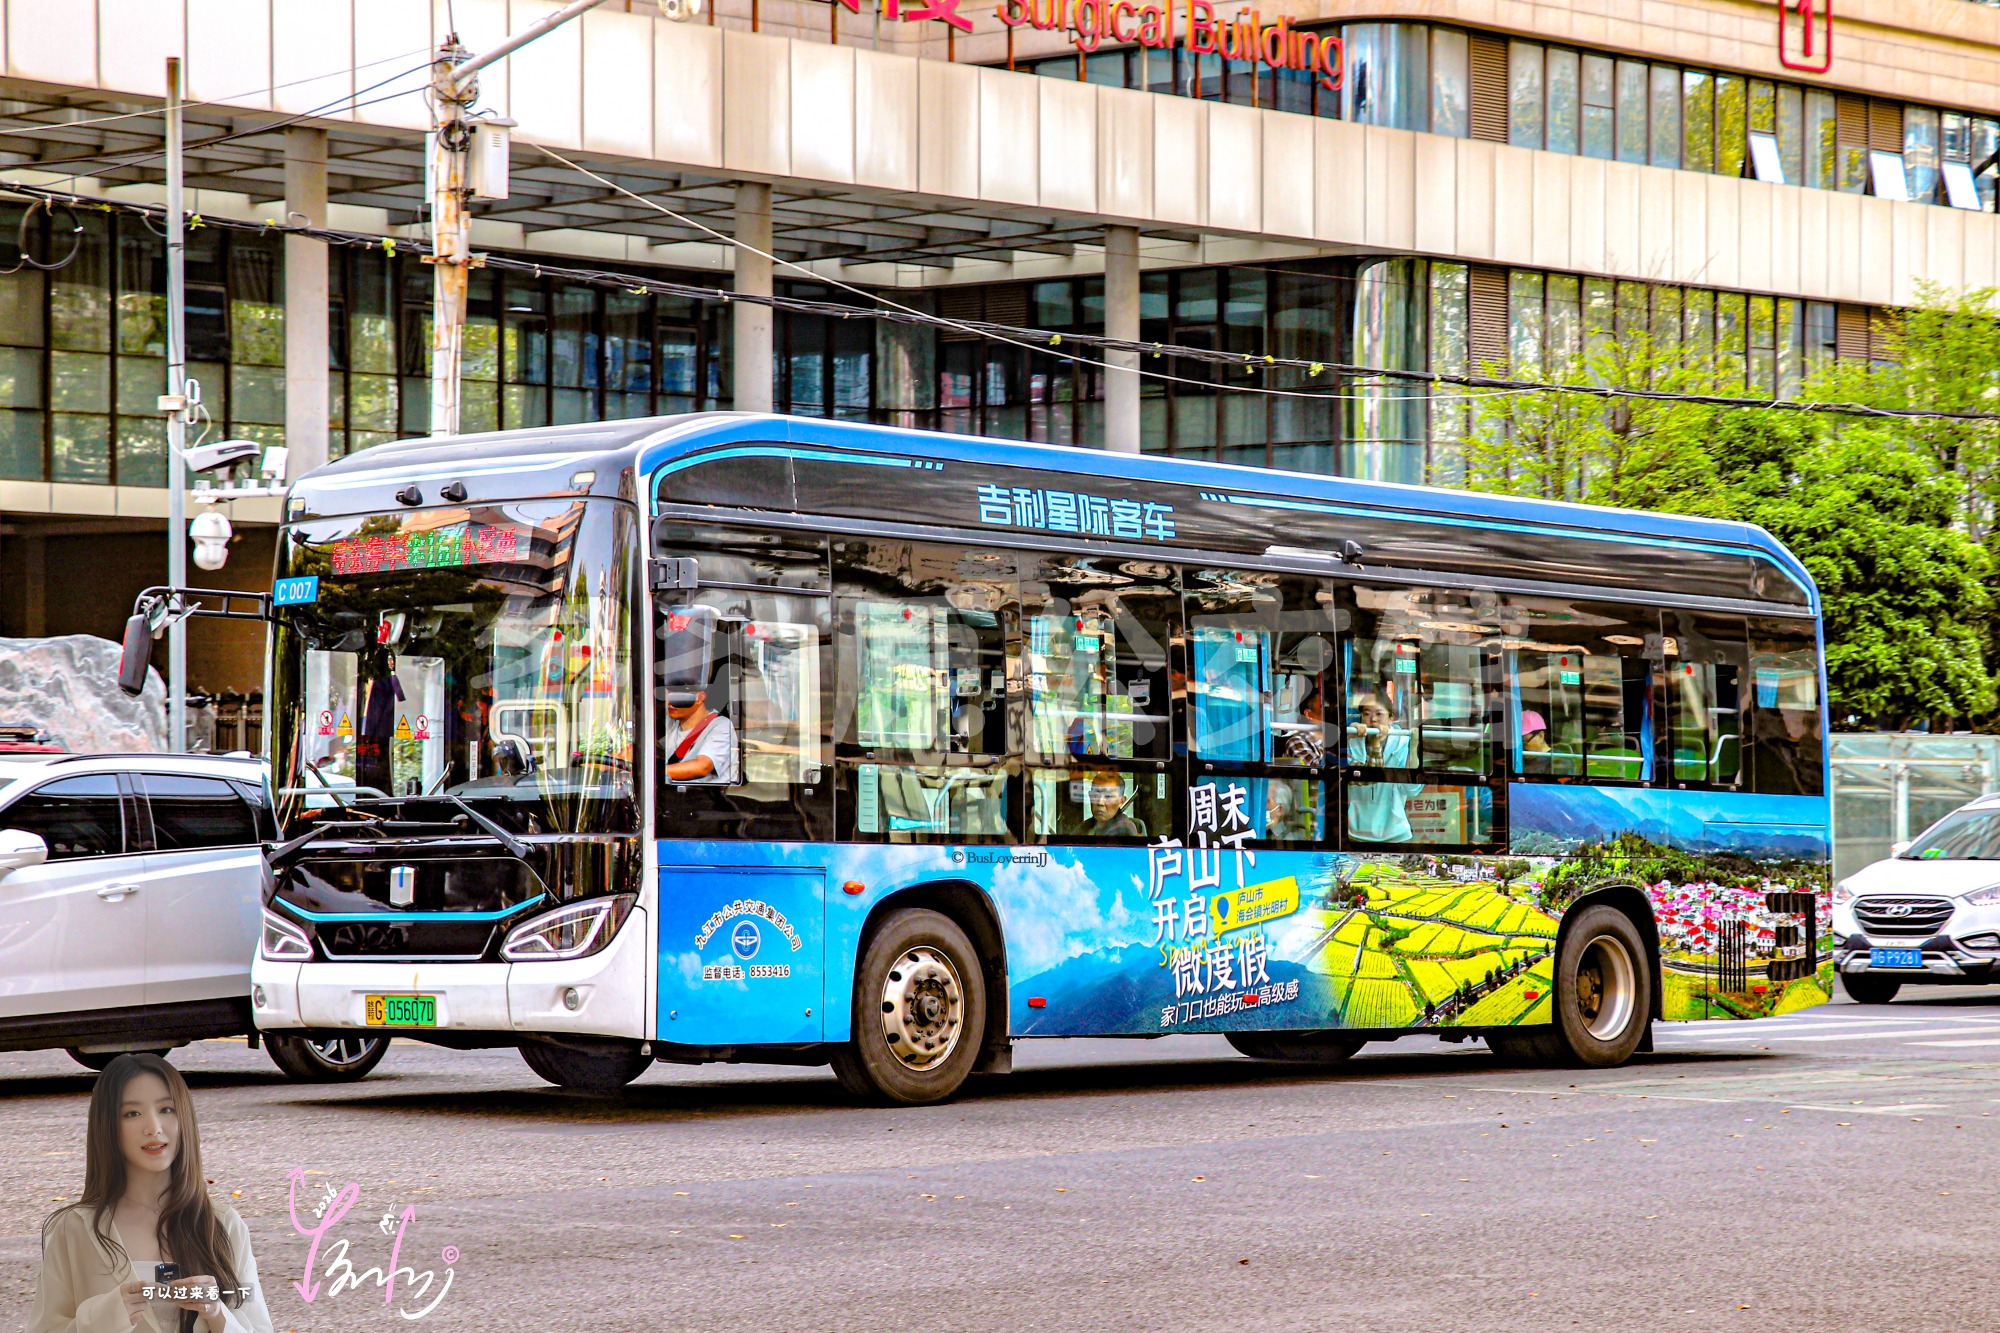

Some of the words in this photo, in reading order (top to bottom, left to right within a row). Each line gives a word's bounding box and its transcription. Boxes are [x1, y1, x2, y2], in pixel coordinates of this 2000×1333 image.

[1187, 0, 1345, 91] Building
[976, 484, 1176, 541] 吉利星际客车
[290, 582, 312, 600] 007
[1189, 782, 1250, 835] 周末
[1405, 799, 1447, 811] 老为
[1147, 829, 1257, 899] 庐山下
[1151, 892, 1207, 943] 开启
[1237, 887, 1263, 906] 庐山市
[695, 899, 802, 952] 九江市公共交通集团公司
[1172, 933, 1270, 998] 微度假
[1159, 979, 1300, 1028] 家门口也能玩出高级感
